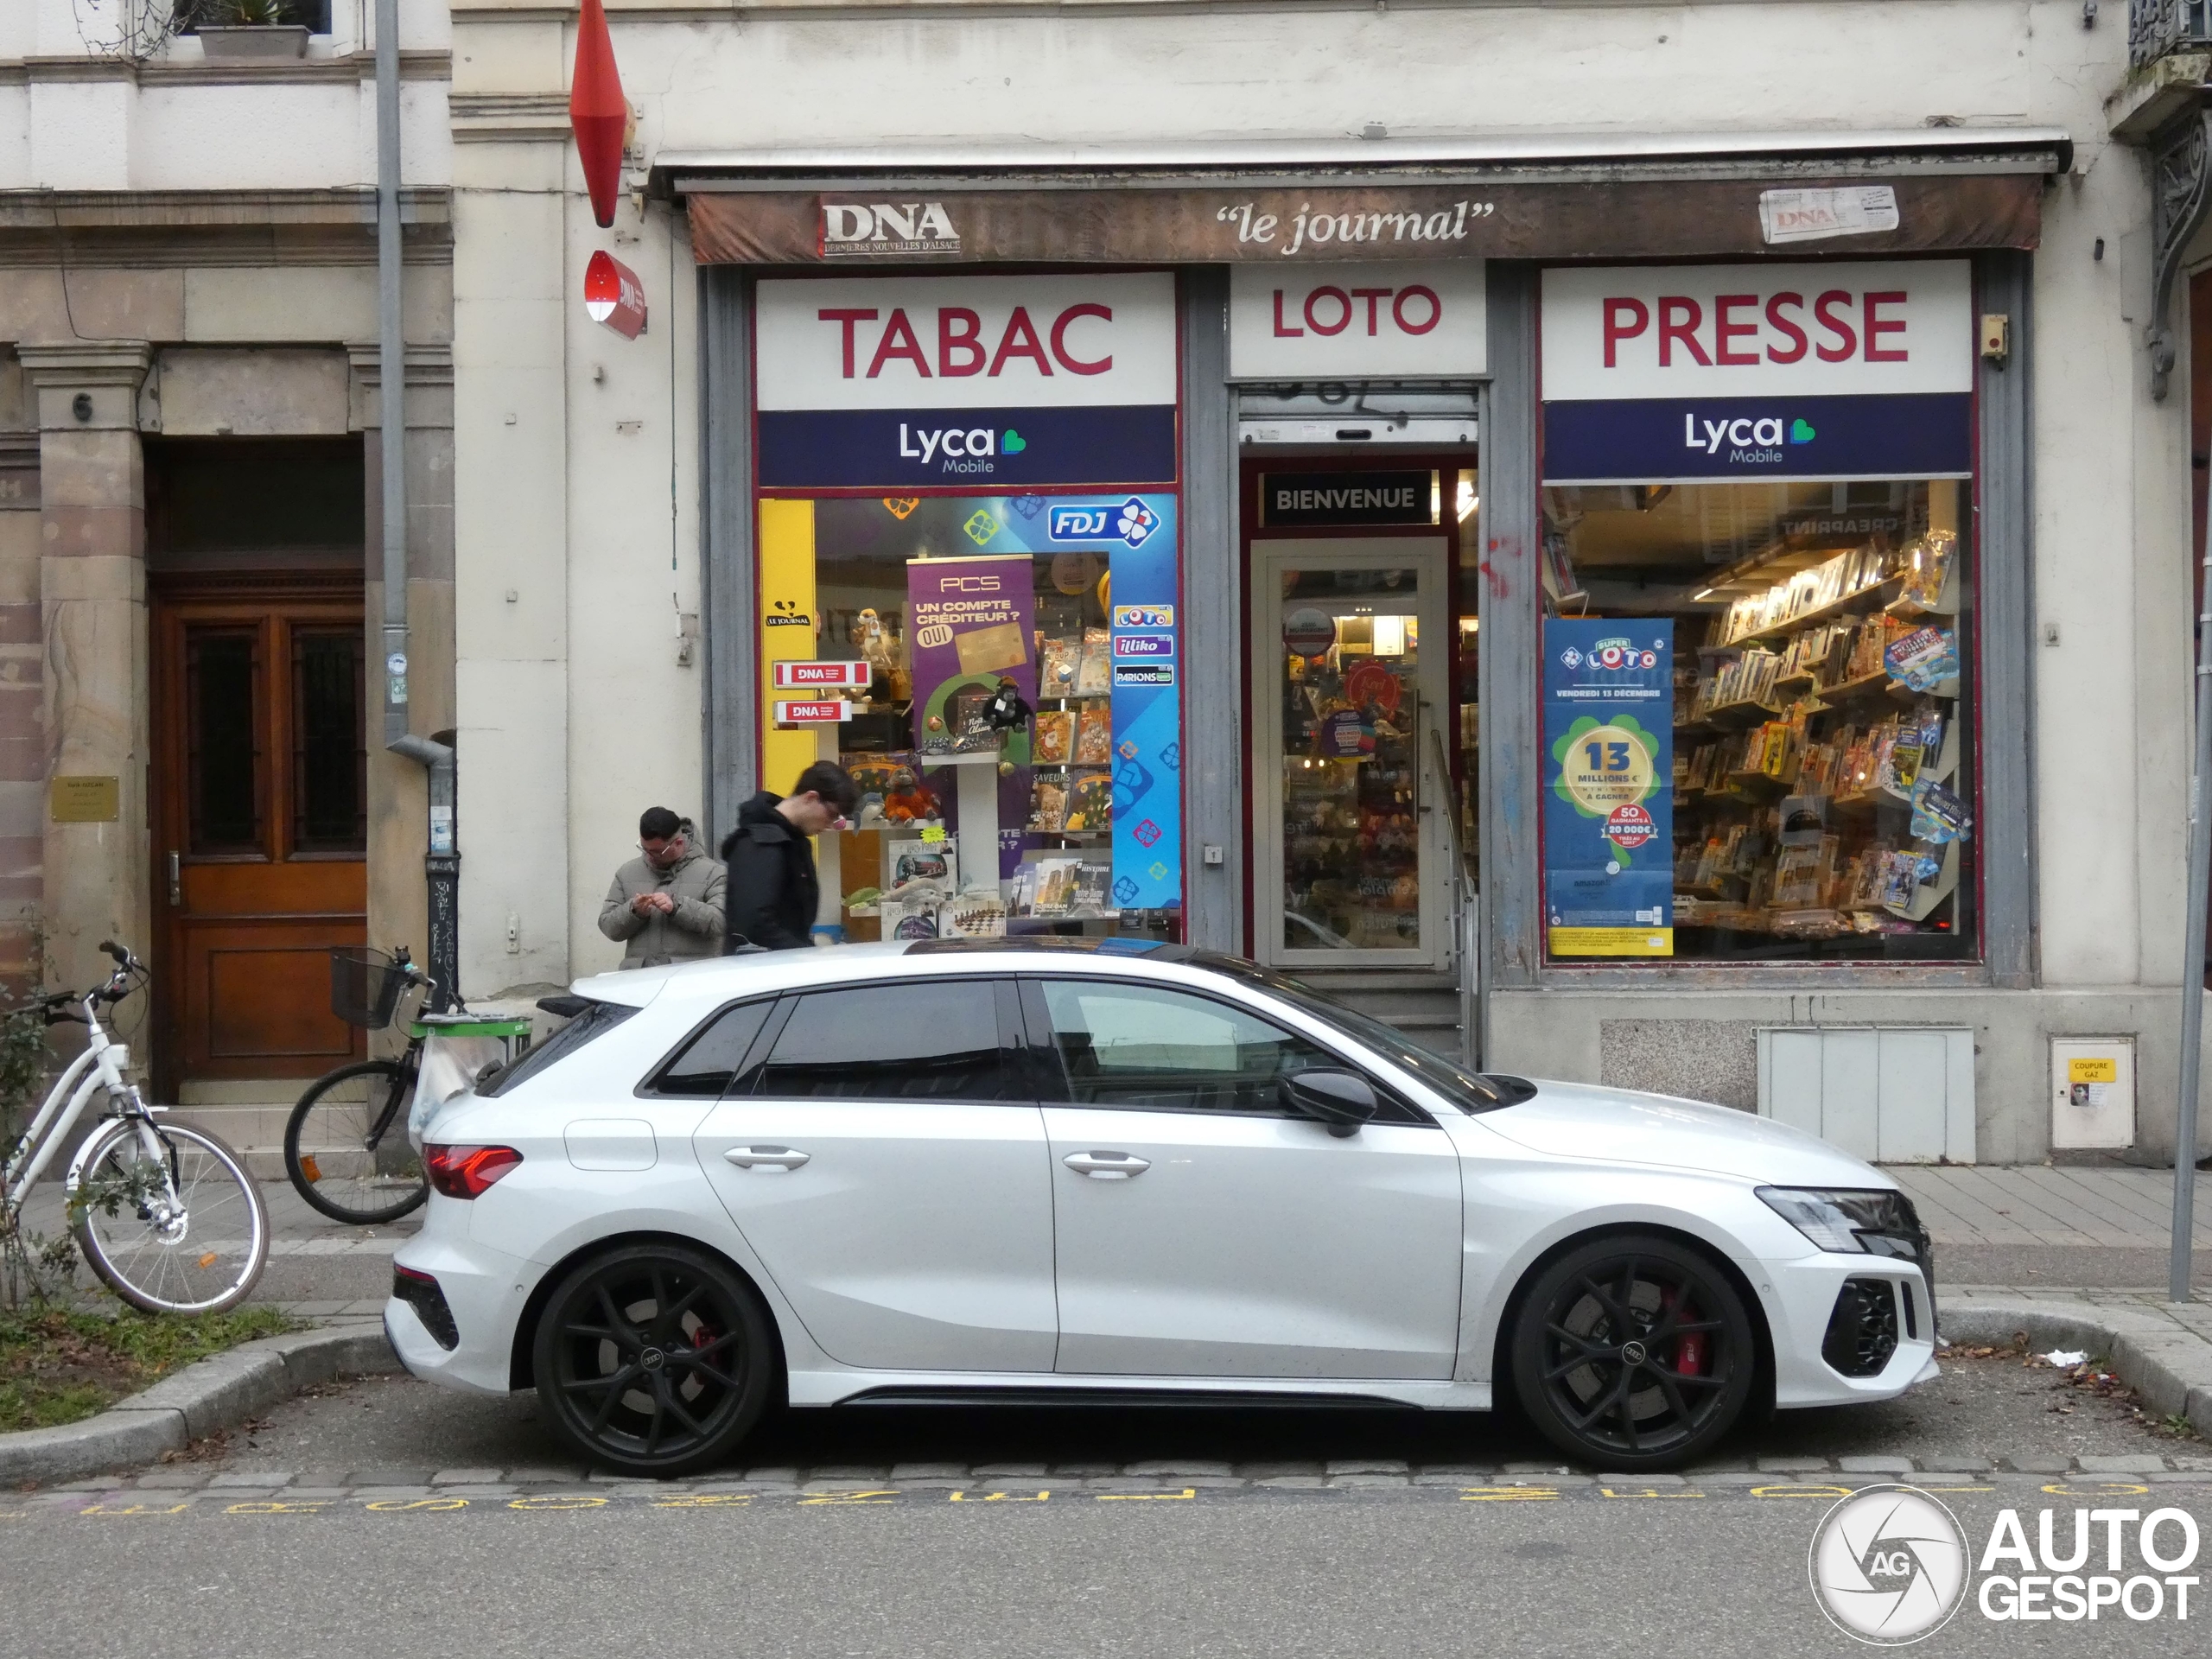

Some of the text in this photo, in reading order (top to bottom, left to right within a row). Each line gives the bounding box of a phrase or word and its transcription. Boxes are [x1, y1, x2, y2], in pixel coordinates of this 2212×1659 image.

[823, 202, 960, 242] DNA
[1776, 208, 1834, 226] DNA
[824, 240, 961, 252] DERNIERES NOUVELLES D'ALSACE
[1273, 284, 1441, 338] LOTO
[1603, 289, 1909, 368] PRESSE
[817, 302, 1113, 378] TABAC
[1686, 413, 1783, 454] Lyca
[899, 423, 995, 464] Lyca
[1729, 448, 1783, 464] Mobile
[942, 459, 995, 474] Mobile
[1276, 487, 1415, 510] BIENVENUE
[1055, 512, 1108, 534] FDJ
[940, 575, 1001, 593] PCS
[916, 600, 1011, 613] UN COMPTE
[916, 611, 1020, 625] CRÉDITEUR ?
[1120, 607, 1166, 626] LOTO
[922, 626, 948, 645] OUI
[1598, 640, 1628, 649] SUPER
[1120, 639, 1158, 653] illiko
[1588, 647, 1656, 668] LOTO
[798, 669, 824, 679] DNA
[1116, 672, 1157, 682] PARIONS
[1614, 689, 1660, 697] DÉCEMBRE
[792, 707, 819, 716] DNA
[1585, 742, 1630, 771] 13
[1033, 773, 1071, 783] SAVEURS
[1621, 807, 1639, 817] 50
[1609, 825, 1622, 834] 20
[1686, 1343, 1694, 1363] RS
